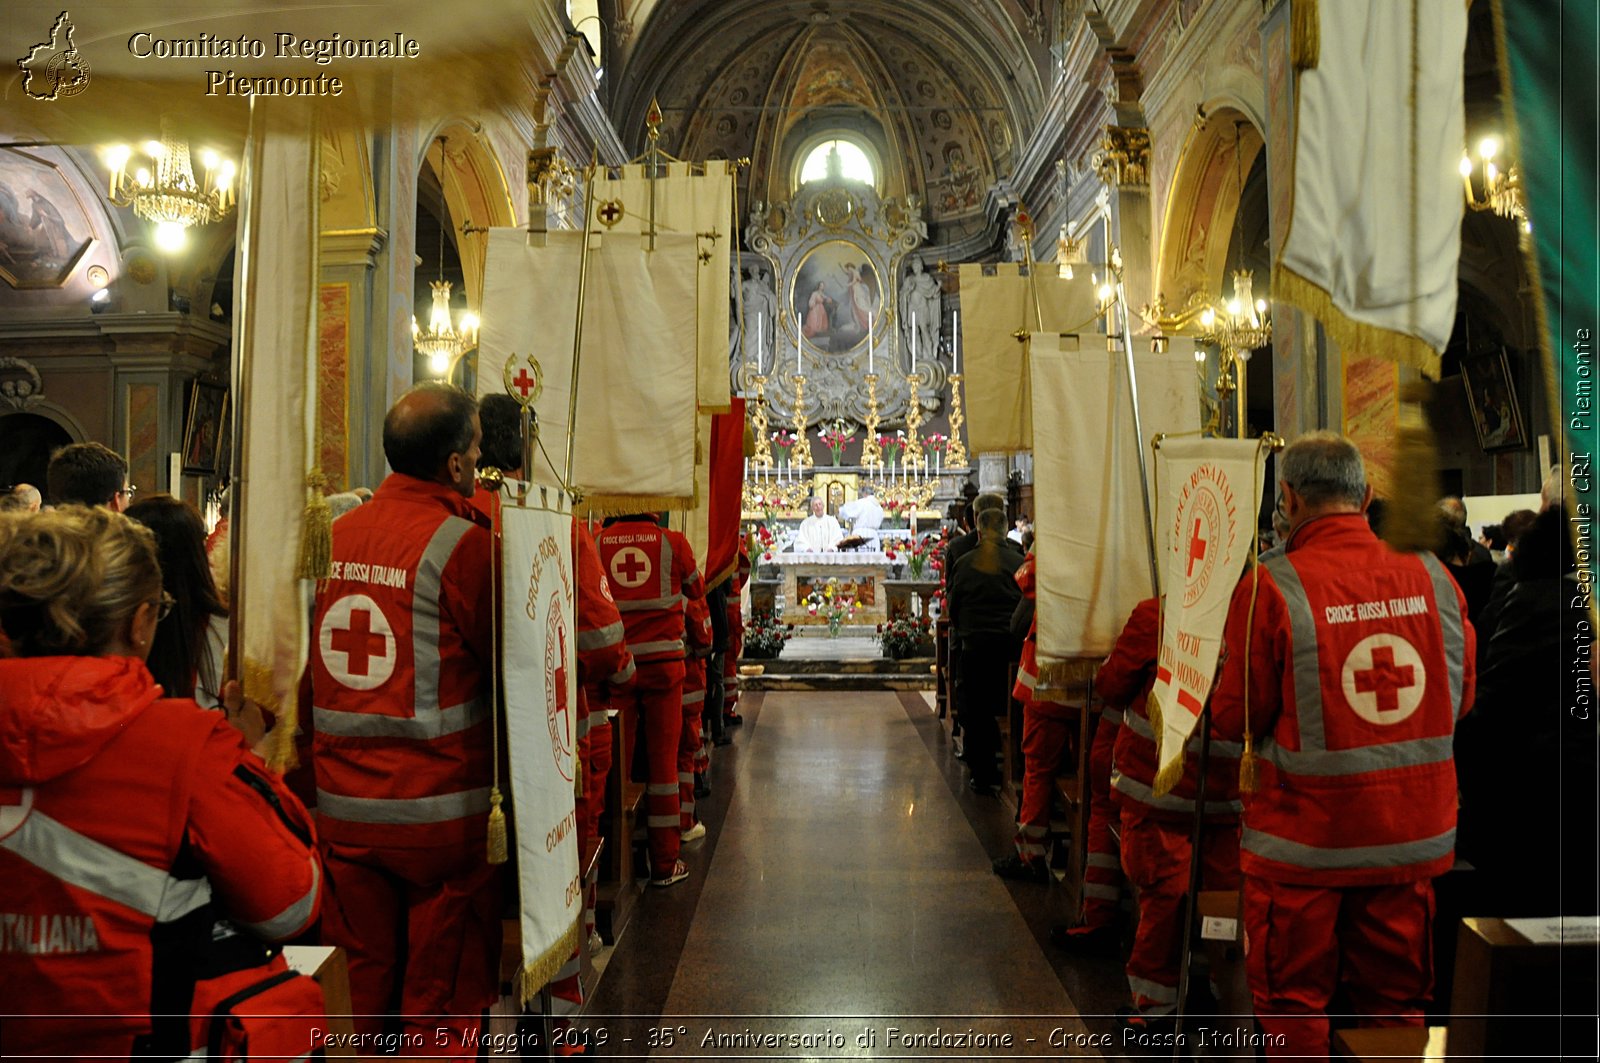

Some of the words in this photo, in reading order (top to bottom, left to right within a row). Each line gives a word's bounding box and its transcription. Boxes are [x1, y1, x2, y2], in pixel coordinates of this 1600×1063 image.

[1190, 463, 1216, 489] ROSSA
[1216, 469, 1236, 565] ITALIANA
[603, 535, 618, 544] CROCE
[619, 534, 634, 543] ROSSA
[635, 533, 657, 543] ITALIANA
[343, 562, 371, 584] ROSSA
[371, 565, 408, 590] ITALIANA
[526, 553, 542, 620] CROCE
[1325, 604, 1357, 624] CROCE
[1357, 600, 1389, 621] ROSSA
[1389, 595, 1429, 617] ITALIANA
[546, 809, 576, 853] COMITAT
